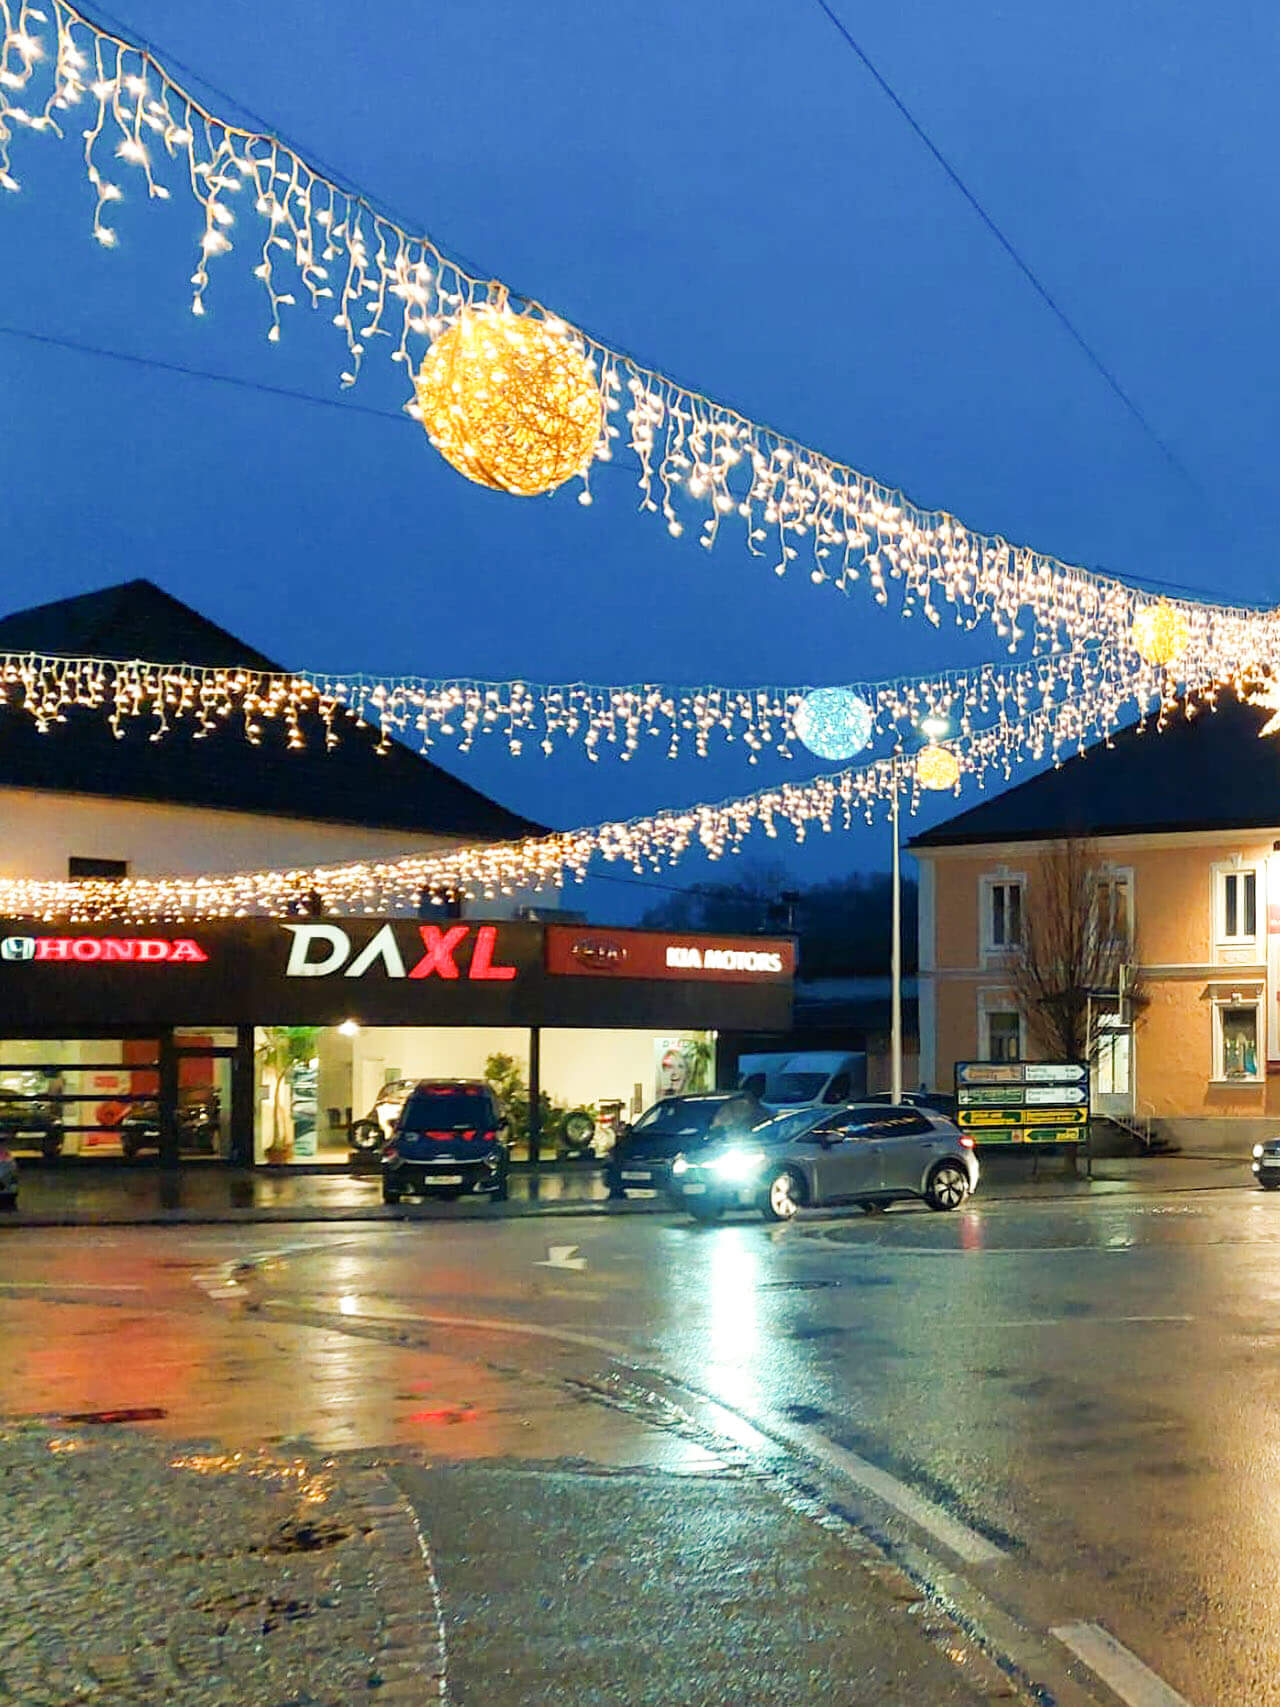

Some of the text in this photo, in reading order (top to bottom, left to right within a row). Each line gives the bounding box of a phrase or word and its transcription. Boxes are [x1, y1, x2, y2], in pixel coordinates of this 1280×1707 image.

[34, 938, 208, 961] HONDA
[279, 923, 517, 979] DAXL
[666, 947, 782, 972] KIA MOTORS
